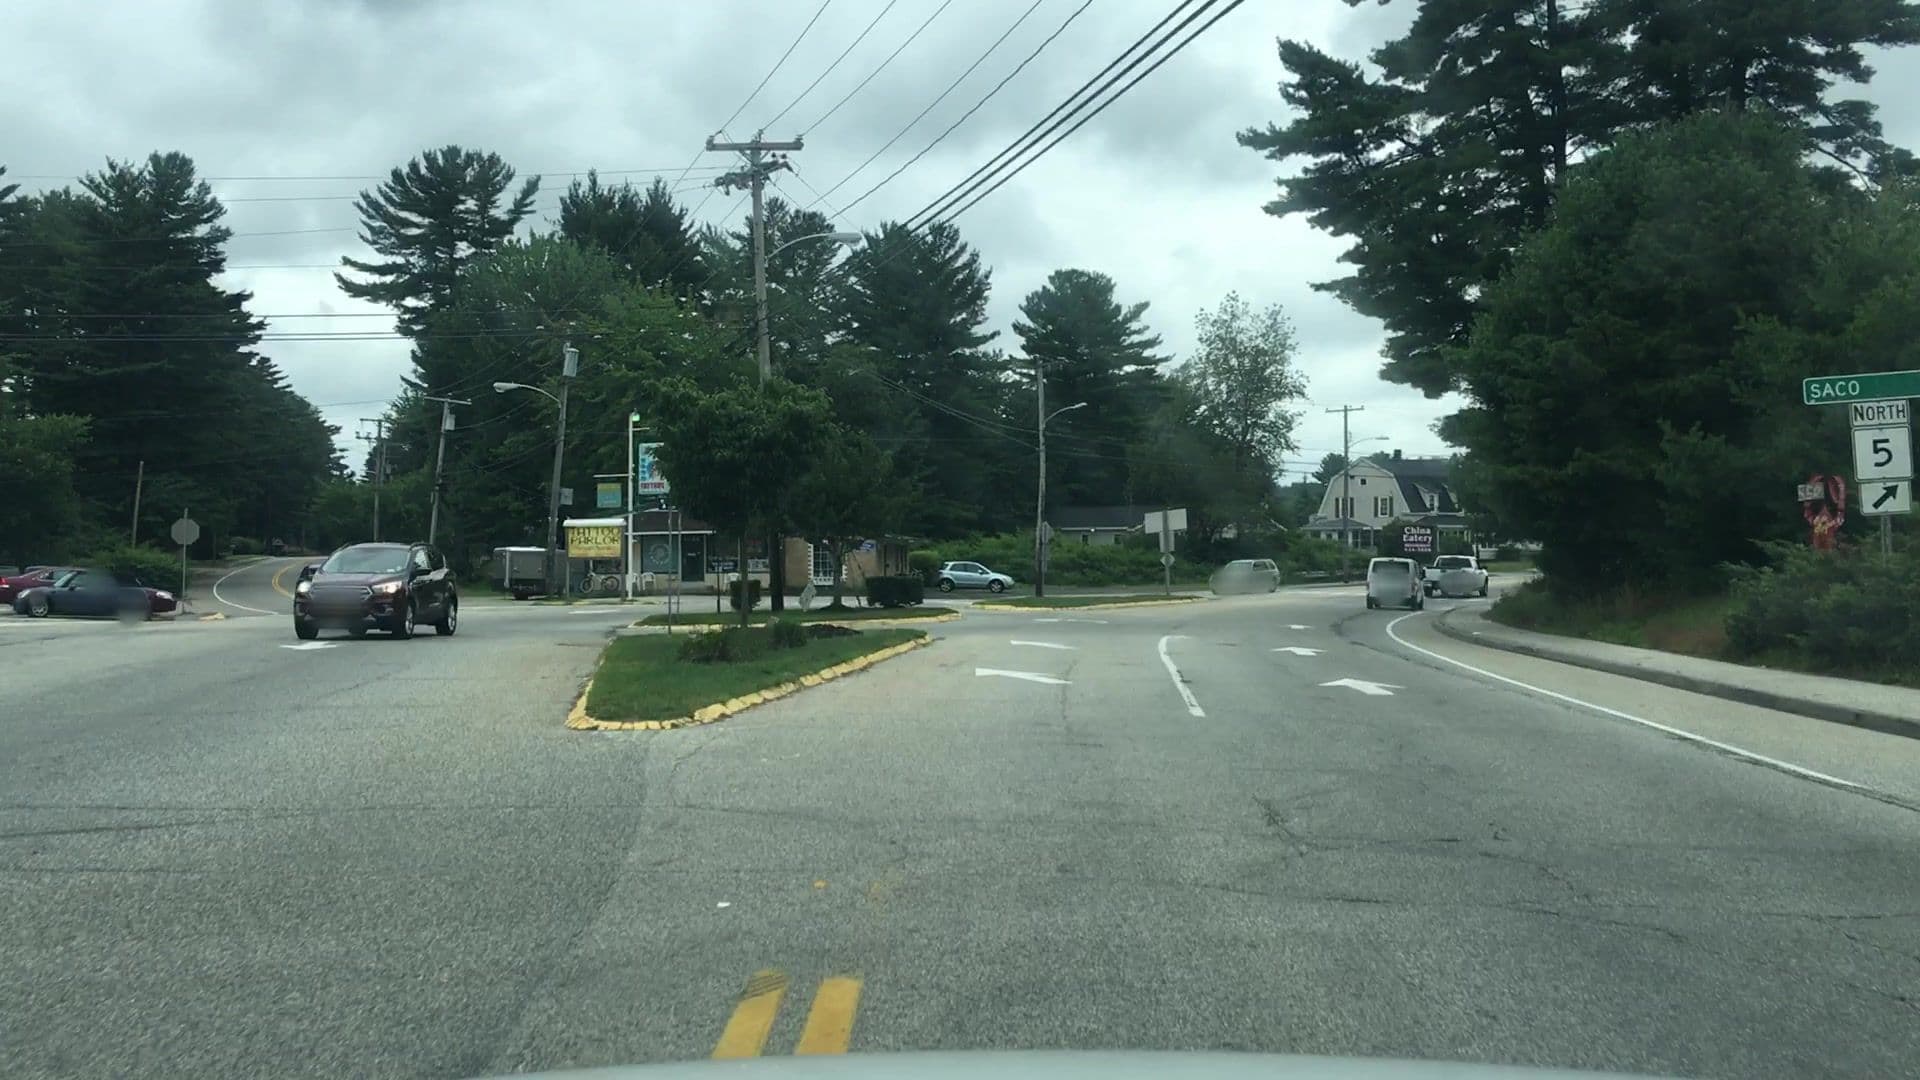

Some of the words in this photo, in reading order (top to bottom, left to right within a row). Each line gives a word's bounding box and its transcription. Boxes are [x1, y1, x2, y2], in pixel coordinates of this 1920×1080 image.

[1810, 380, 1860, 398] SACO
[1854, 404, 1906, 422] NORTH
[1872, 439, 1893, 467] 5
[568, 526, 621, 536] TATTOO
[1404, 526, 1431, 534] China
[570, 536, 620, 545] PARLOR
[1403, 534, 1432, 543] Eatery
